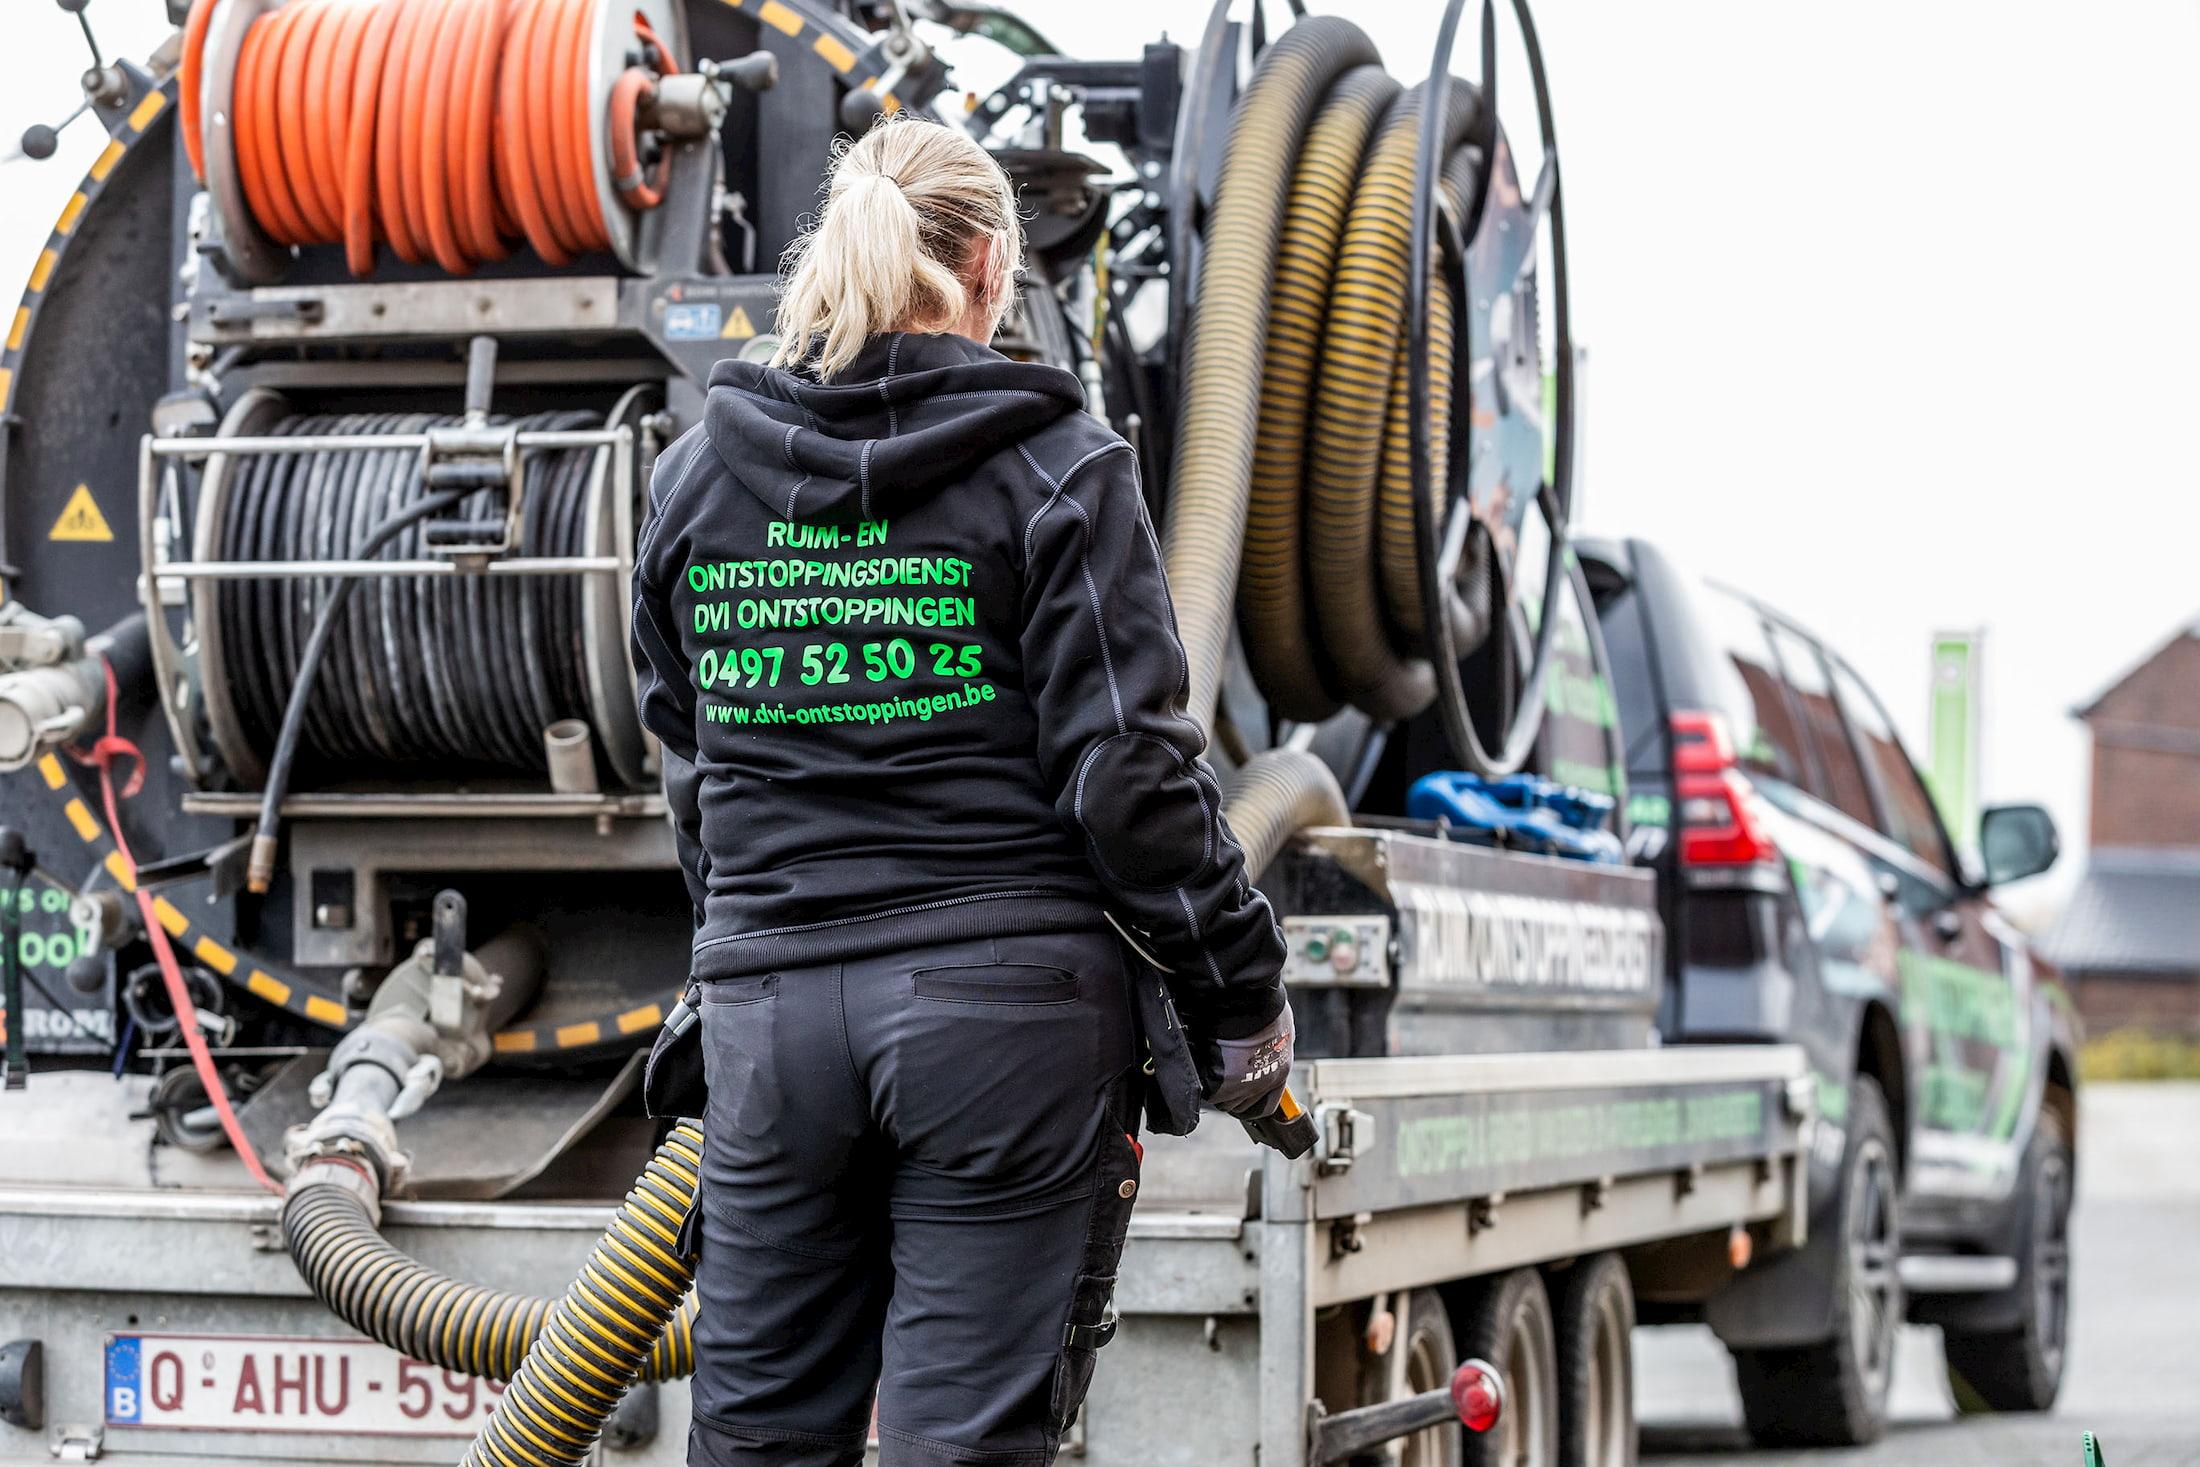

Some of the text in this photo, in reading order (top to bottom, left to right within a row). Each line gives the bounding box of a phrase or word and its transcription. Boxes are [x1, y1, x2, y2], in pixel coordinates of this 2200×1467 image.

[767, 519, 888, 549] RUIM- EN
[688, 557, 972, 592] ONTSTOPPINGSDIENST
[694, 597, 975, 634] DVI ONTSTOPPINGEN
[699, 638, 982, 690] 0497 52 50 25
[705, 682, 996, 725] www.dvi-ontstoppingen.be
[113, 1387, 137, 1418] B
